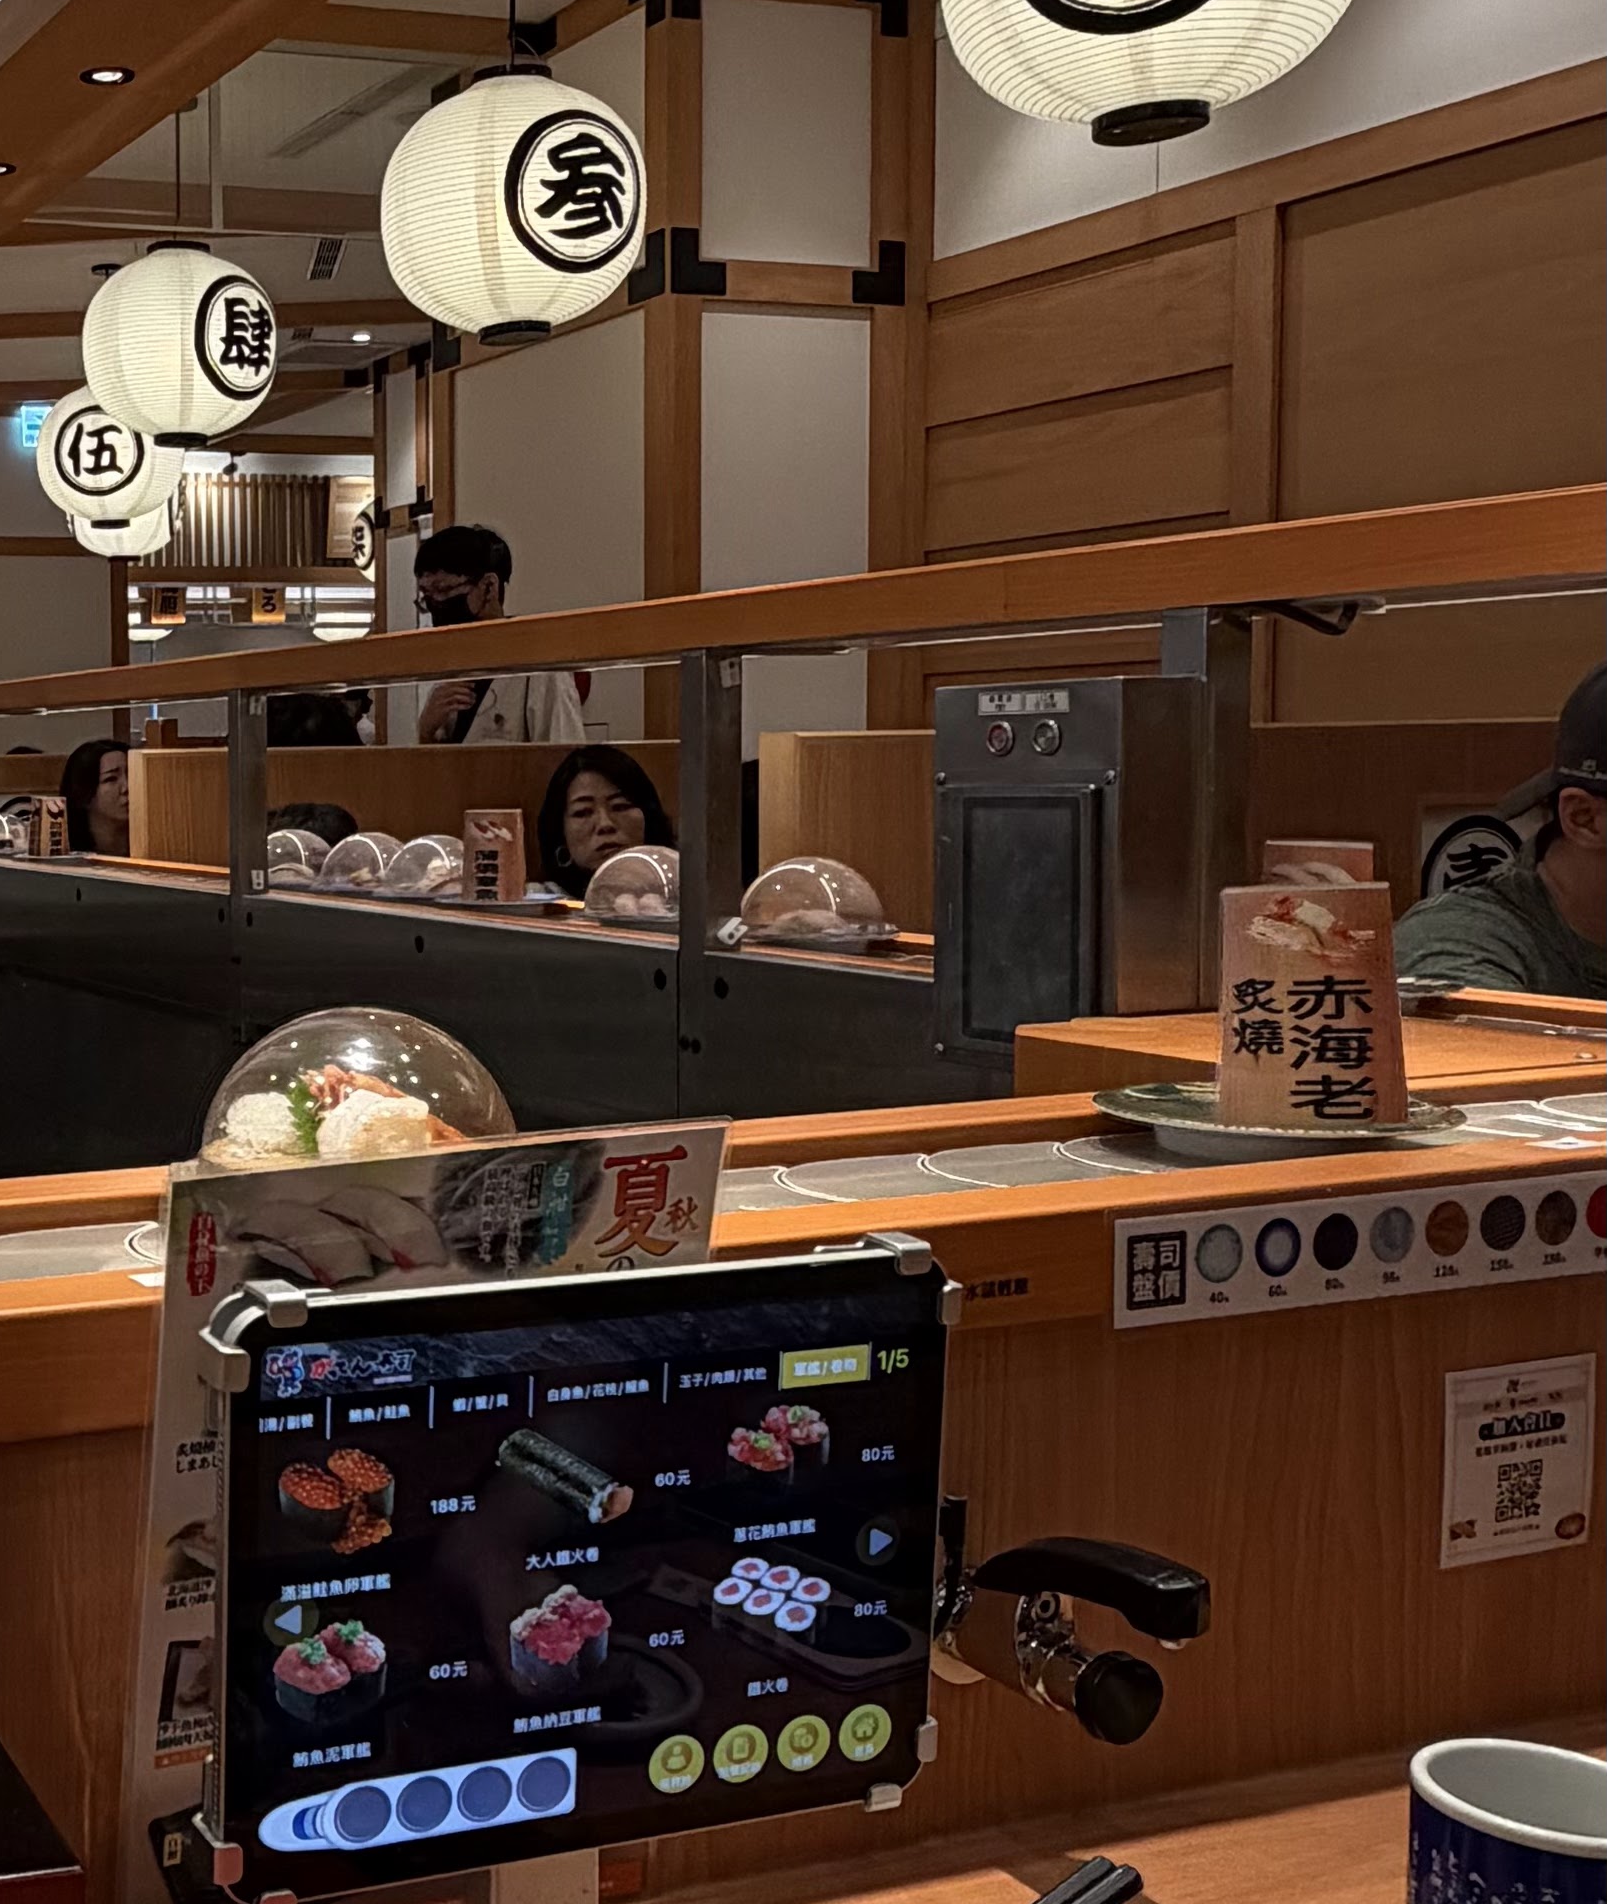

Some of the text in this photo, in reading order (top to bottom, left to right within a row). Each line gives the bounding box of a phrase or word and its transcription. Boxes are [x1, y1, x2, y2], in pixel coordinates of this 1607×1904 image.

[220, 297, 273, 377] 肆
[68, 423, 123, 478] 伍
[1232, 979, 1284, 1059] 炙燒
[1287, 975, 1376, 1121] 赤海老
[594, 1145, 688, 1258] 夏
[664, 1196, 699, 1234] 秋
[877, 1348, 910, 1375] 1/5
[862, 1446, 895, 1463] 80元
[655, 1470, 692, 1488] 60元
[431, 1495, 476, 1515] 188元
[854, 1600, 888, 1618] 80元
[649, 1630, 685, 1648] 60元
[429, 1661, 468, 1680] 60元
